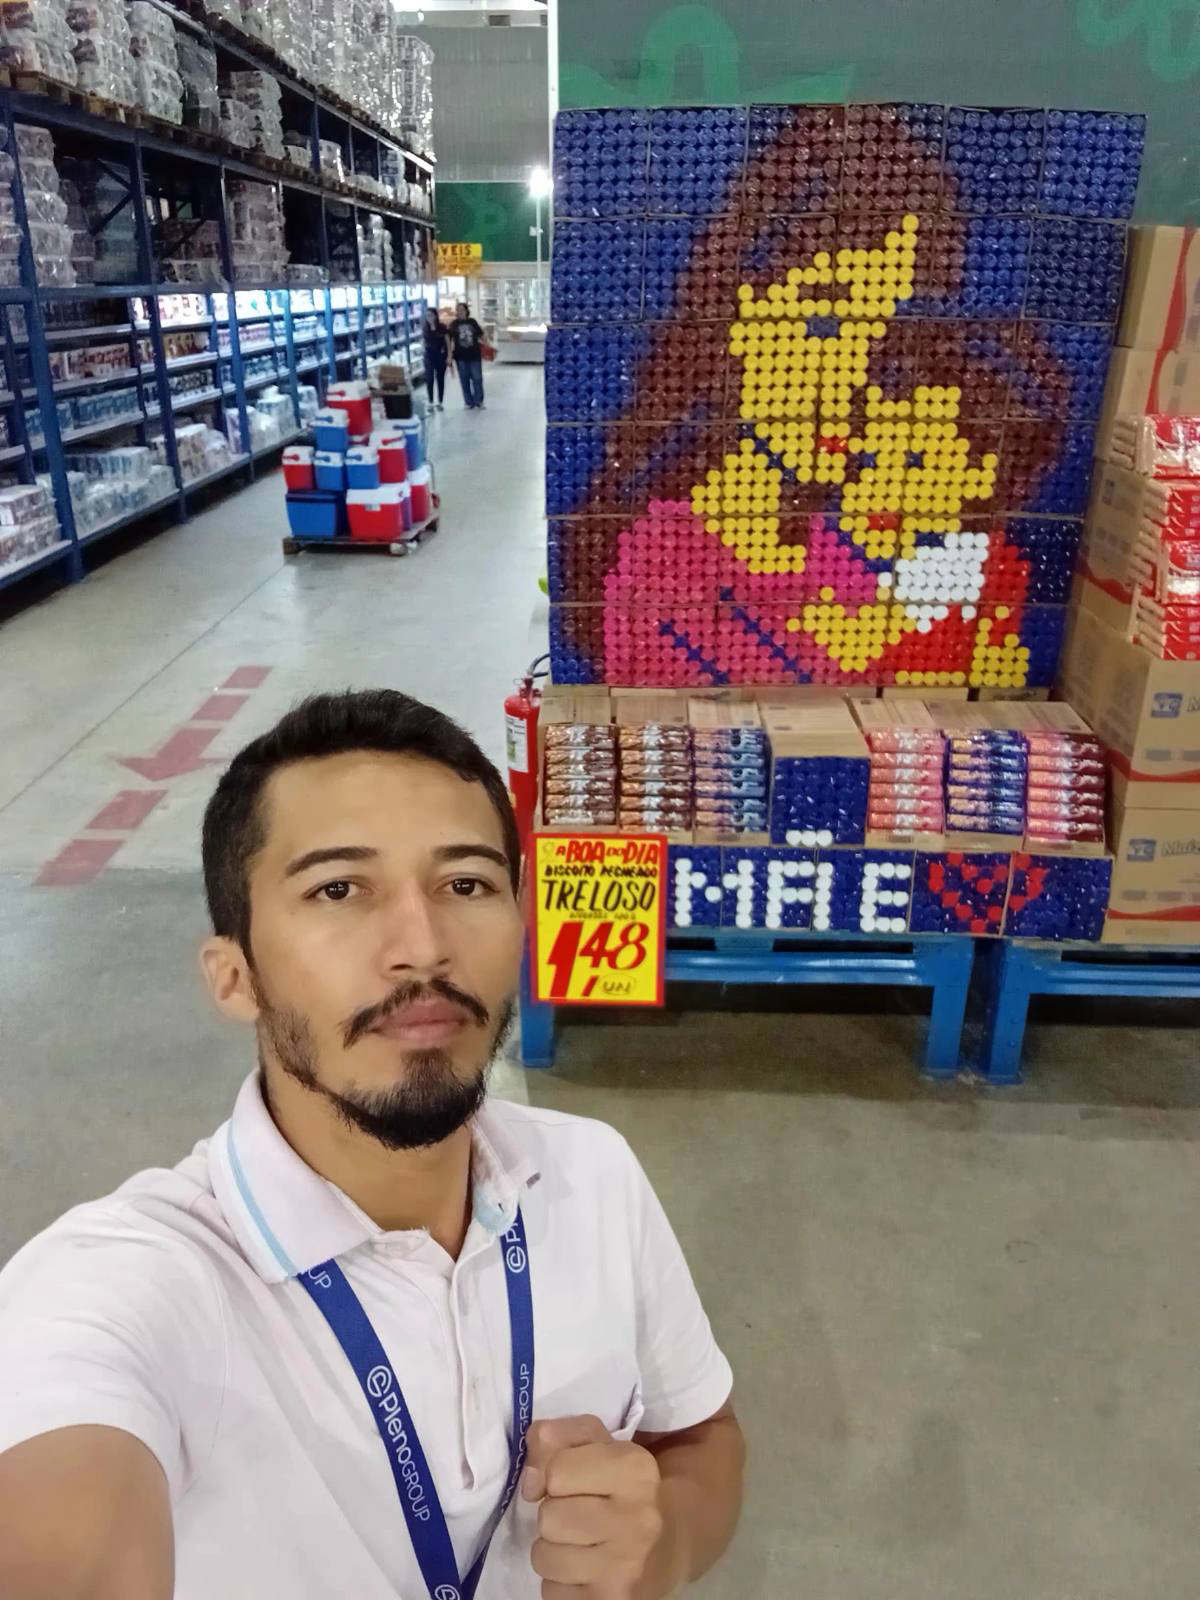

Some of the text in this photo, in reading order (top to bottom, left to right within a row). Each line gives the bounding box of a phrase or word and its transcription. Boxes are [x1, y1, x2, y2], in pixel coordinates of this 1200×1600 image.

[565, 840, 605, 864] BOA
[622, 841, 659, 865] DIA
[541, 879, 656, 912] TRELOSO
